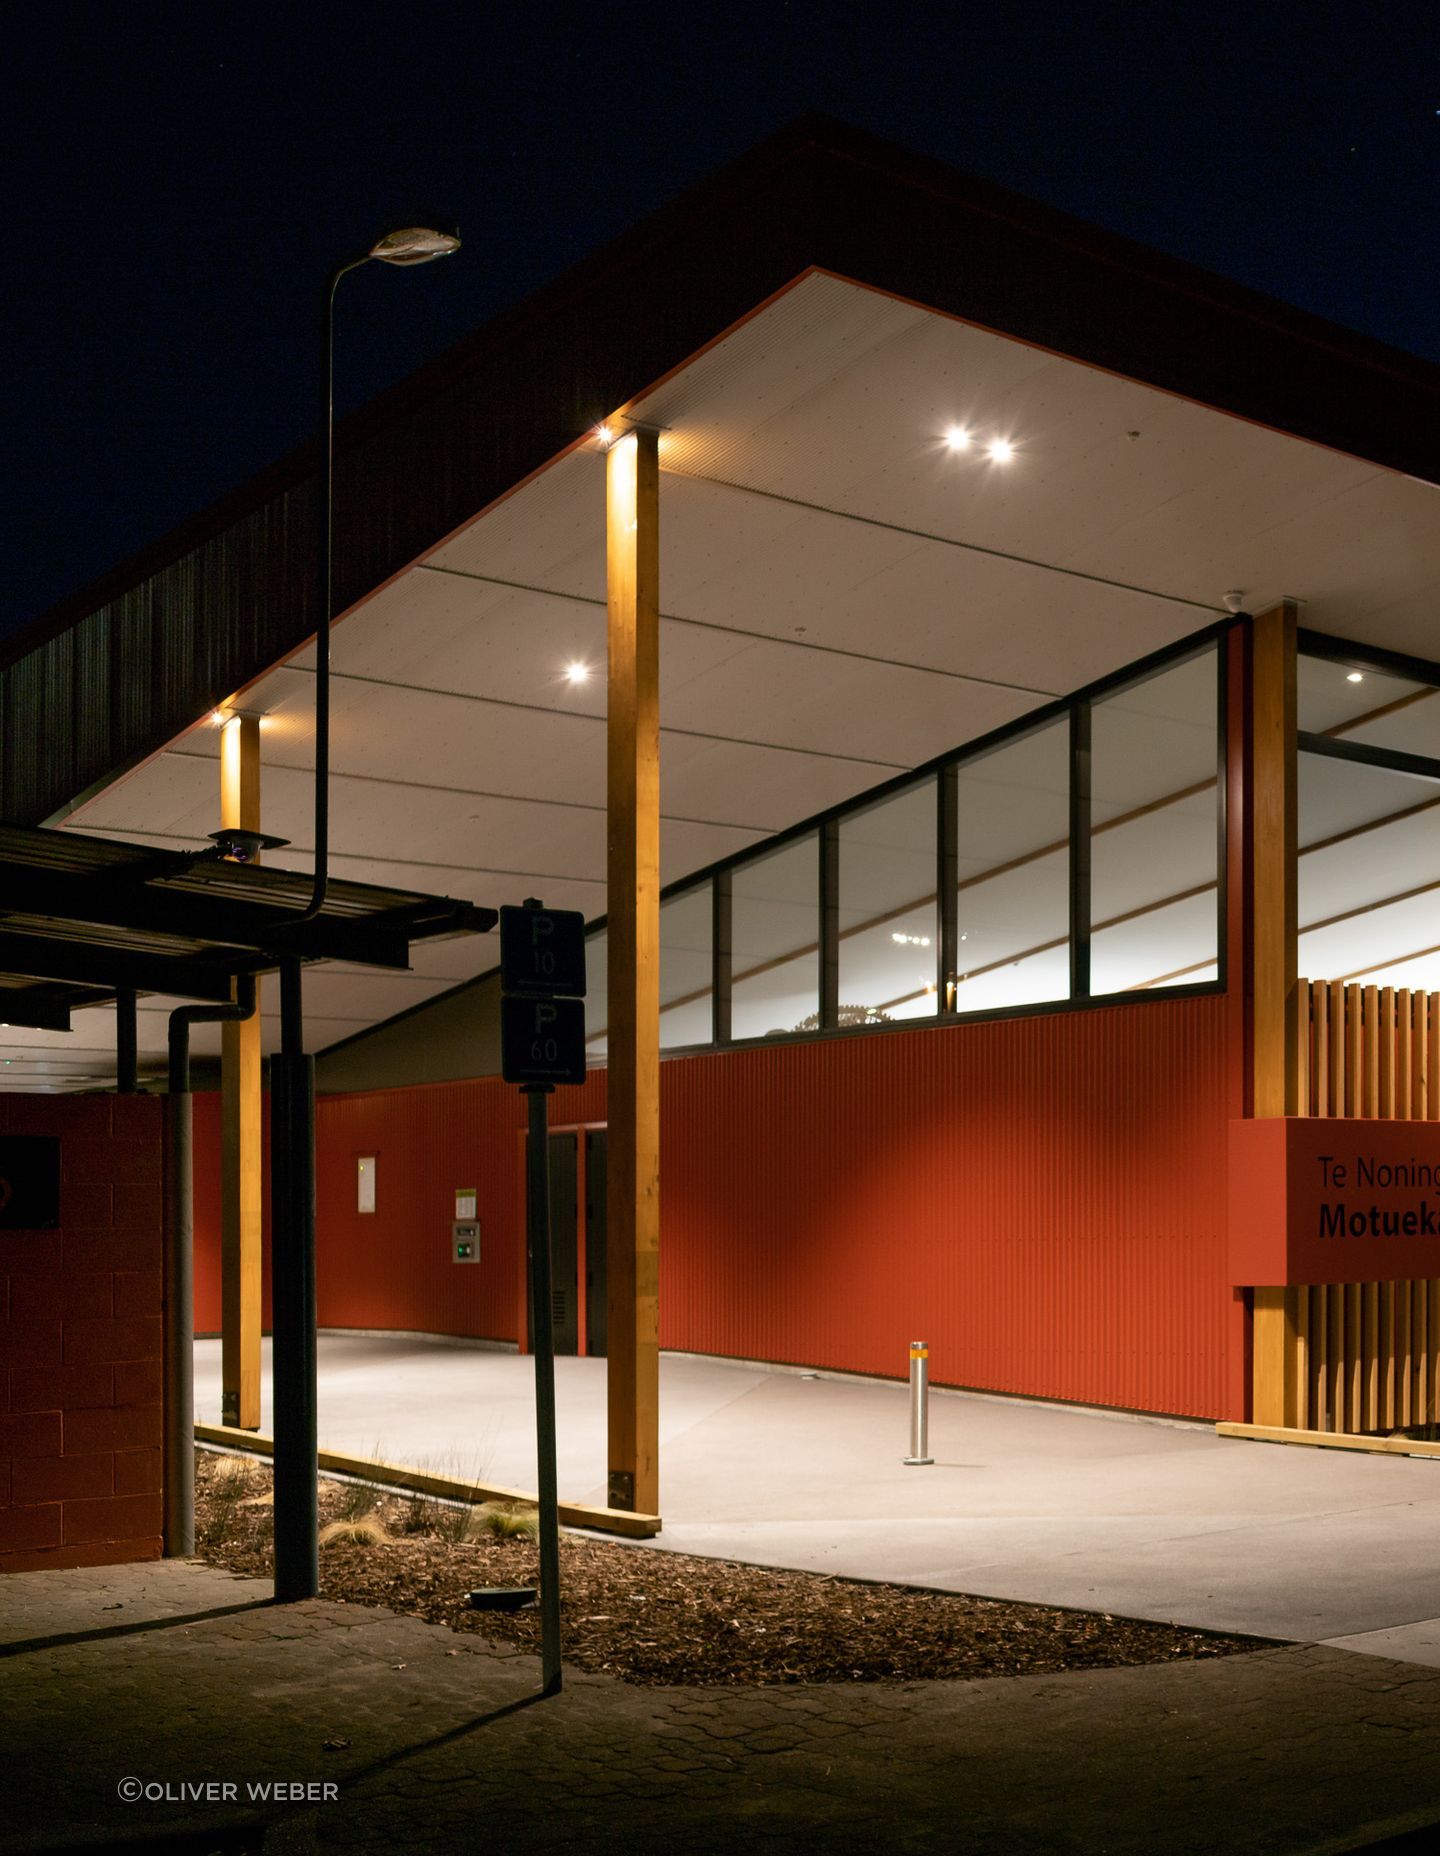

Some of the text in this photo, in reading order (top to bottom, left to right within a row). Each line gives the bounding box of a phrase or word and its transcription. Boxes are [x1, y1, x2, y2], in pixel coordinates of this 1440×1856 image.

[535, 1003, 558, 1034] P
[530, 1038, 558, 1064] 60
[1318, 1157, 1346, 1187] Te
